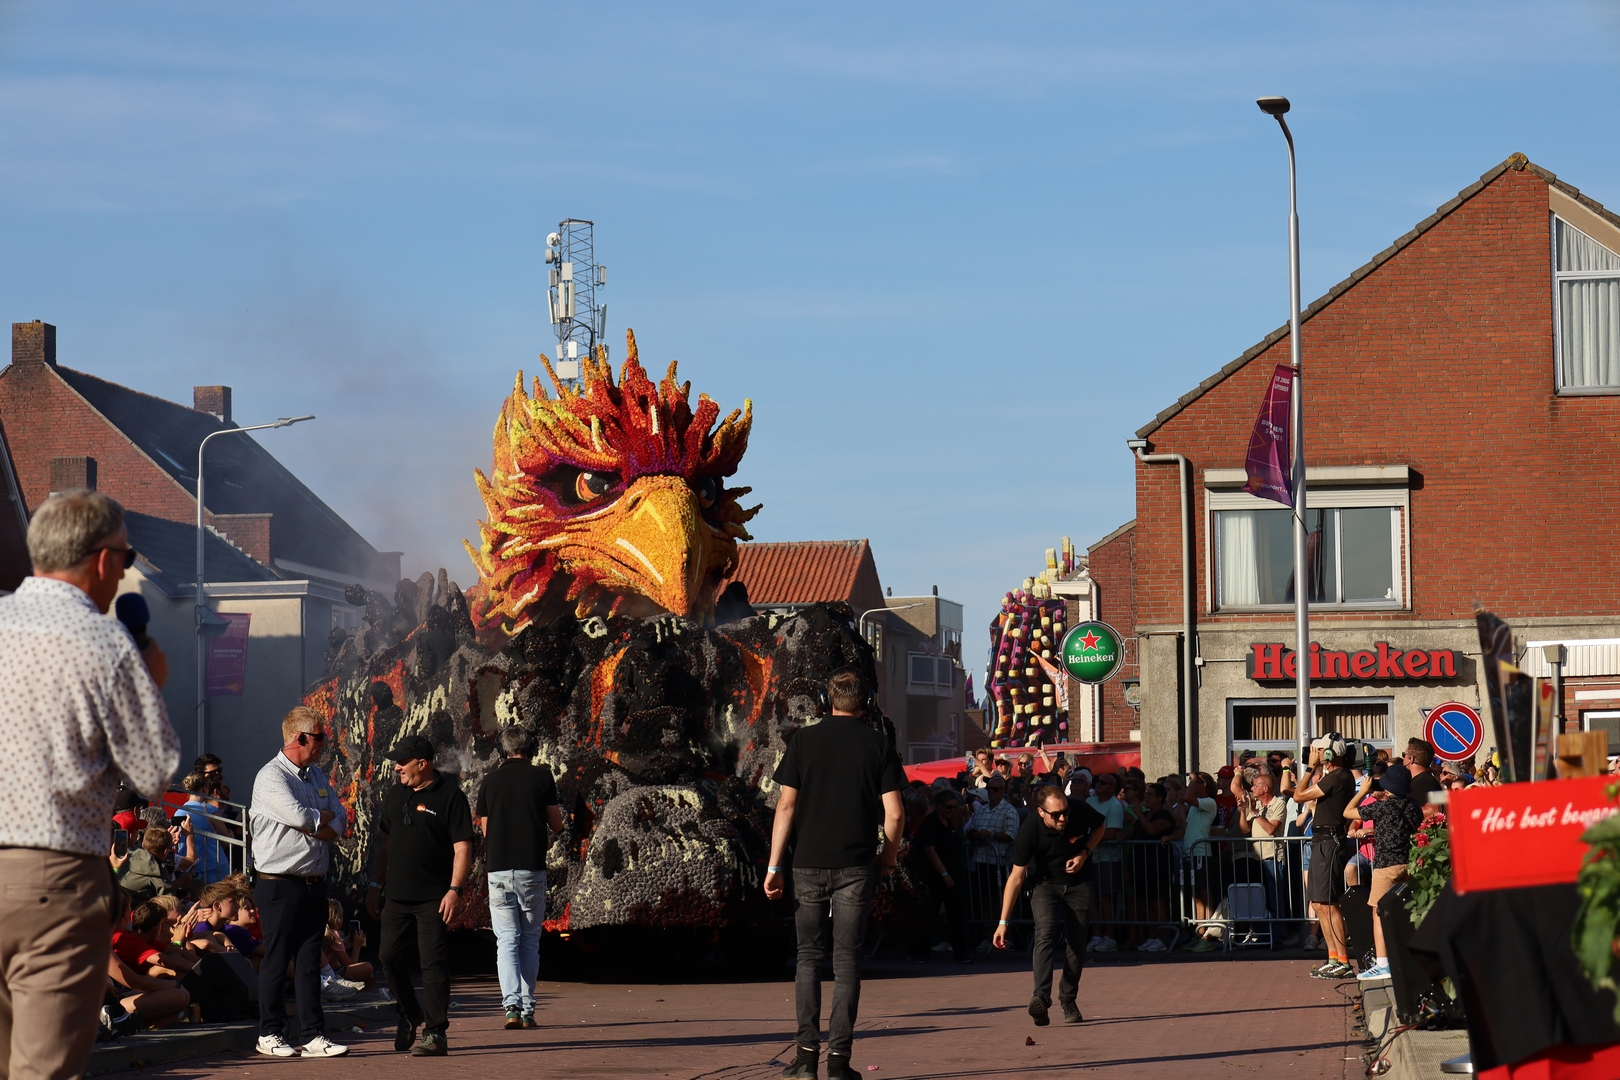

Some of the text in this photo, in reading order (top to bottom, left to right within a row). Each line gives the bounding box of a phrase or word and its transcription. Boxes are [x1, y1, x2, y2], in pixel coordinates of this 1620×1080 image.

[1068, 653, 1115, 664] Heineken
[1251, 641, 1458, 679] Heineken
[1519, 806, 1557, 830] best
